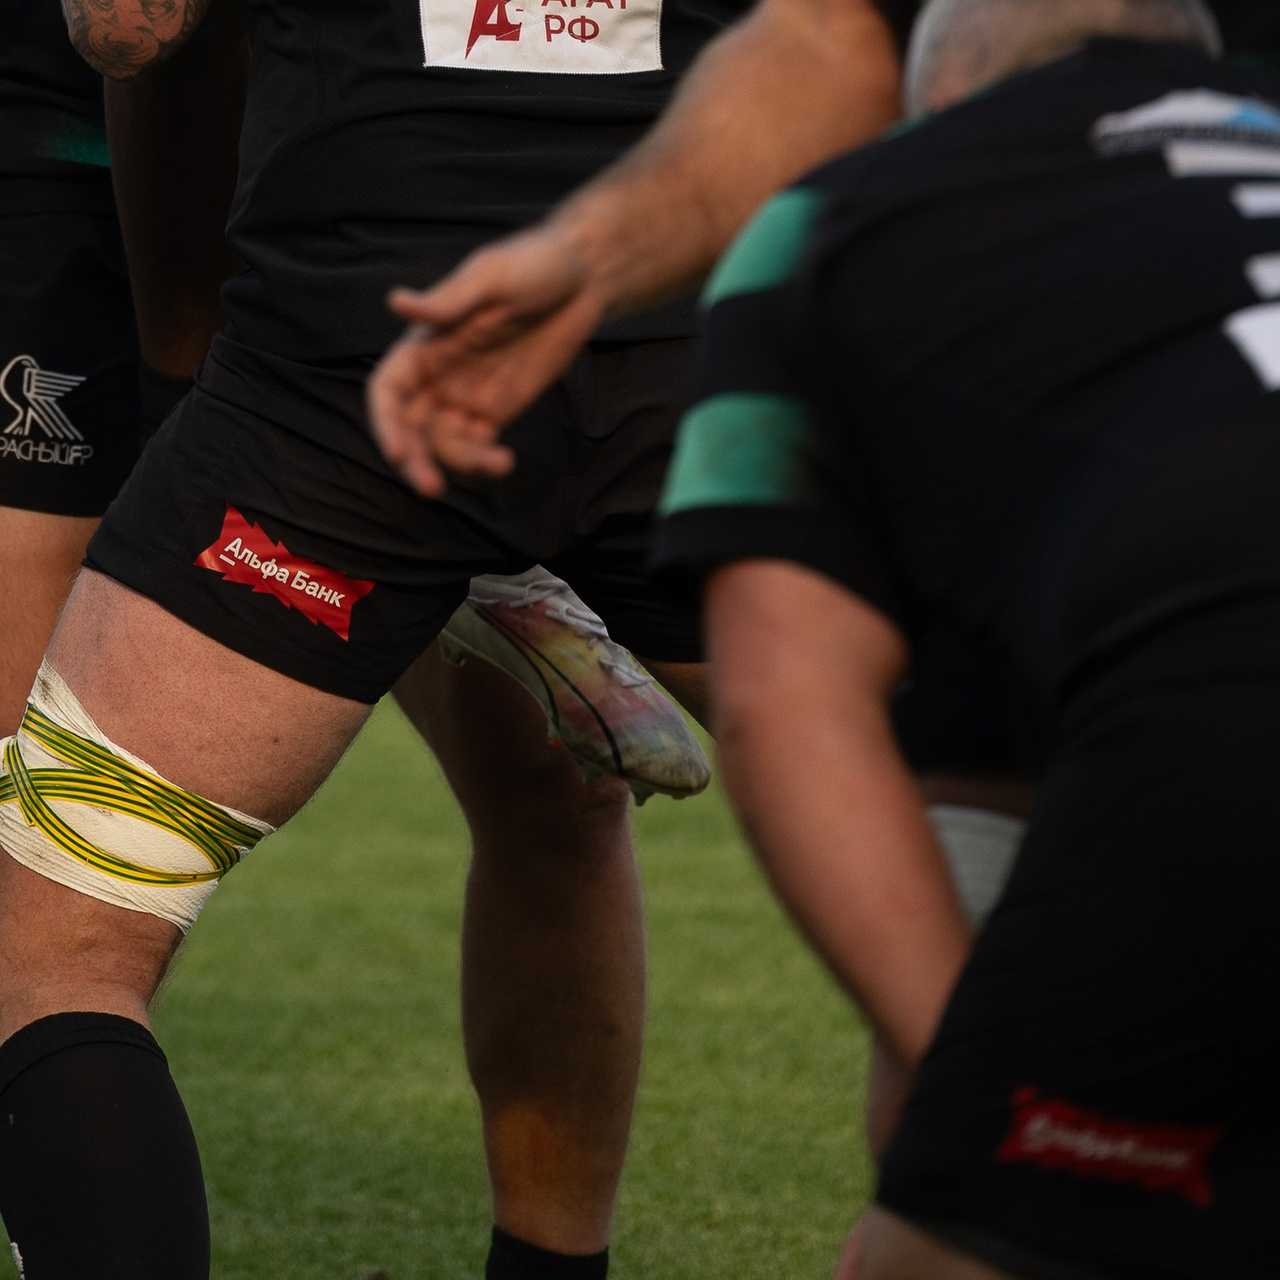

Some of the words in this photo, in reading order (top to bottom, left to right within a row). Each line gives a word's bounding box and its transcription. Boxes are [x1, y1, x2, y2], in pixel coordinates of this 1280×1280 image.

[545, 14, 600, 43] РФ
[220, 537, 290, 584] Альфа
[291, 570, 345, 608] Банк
